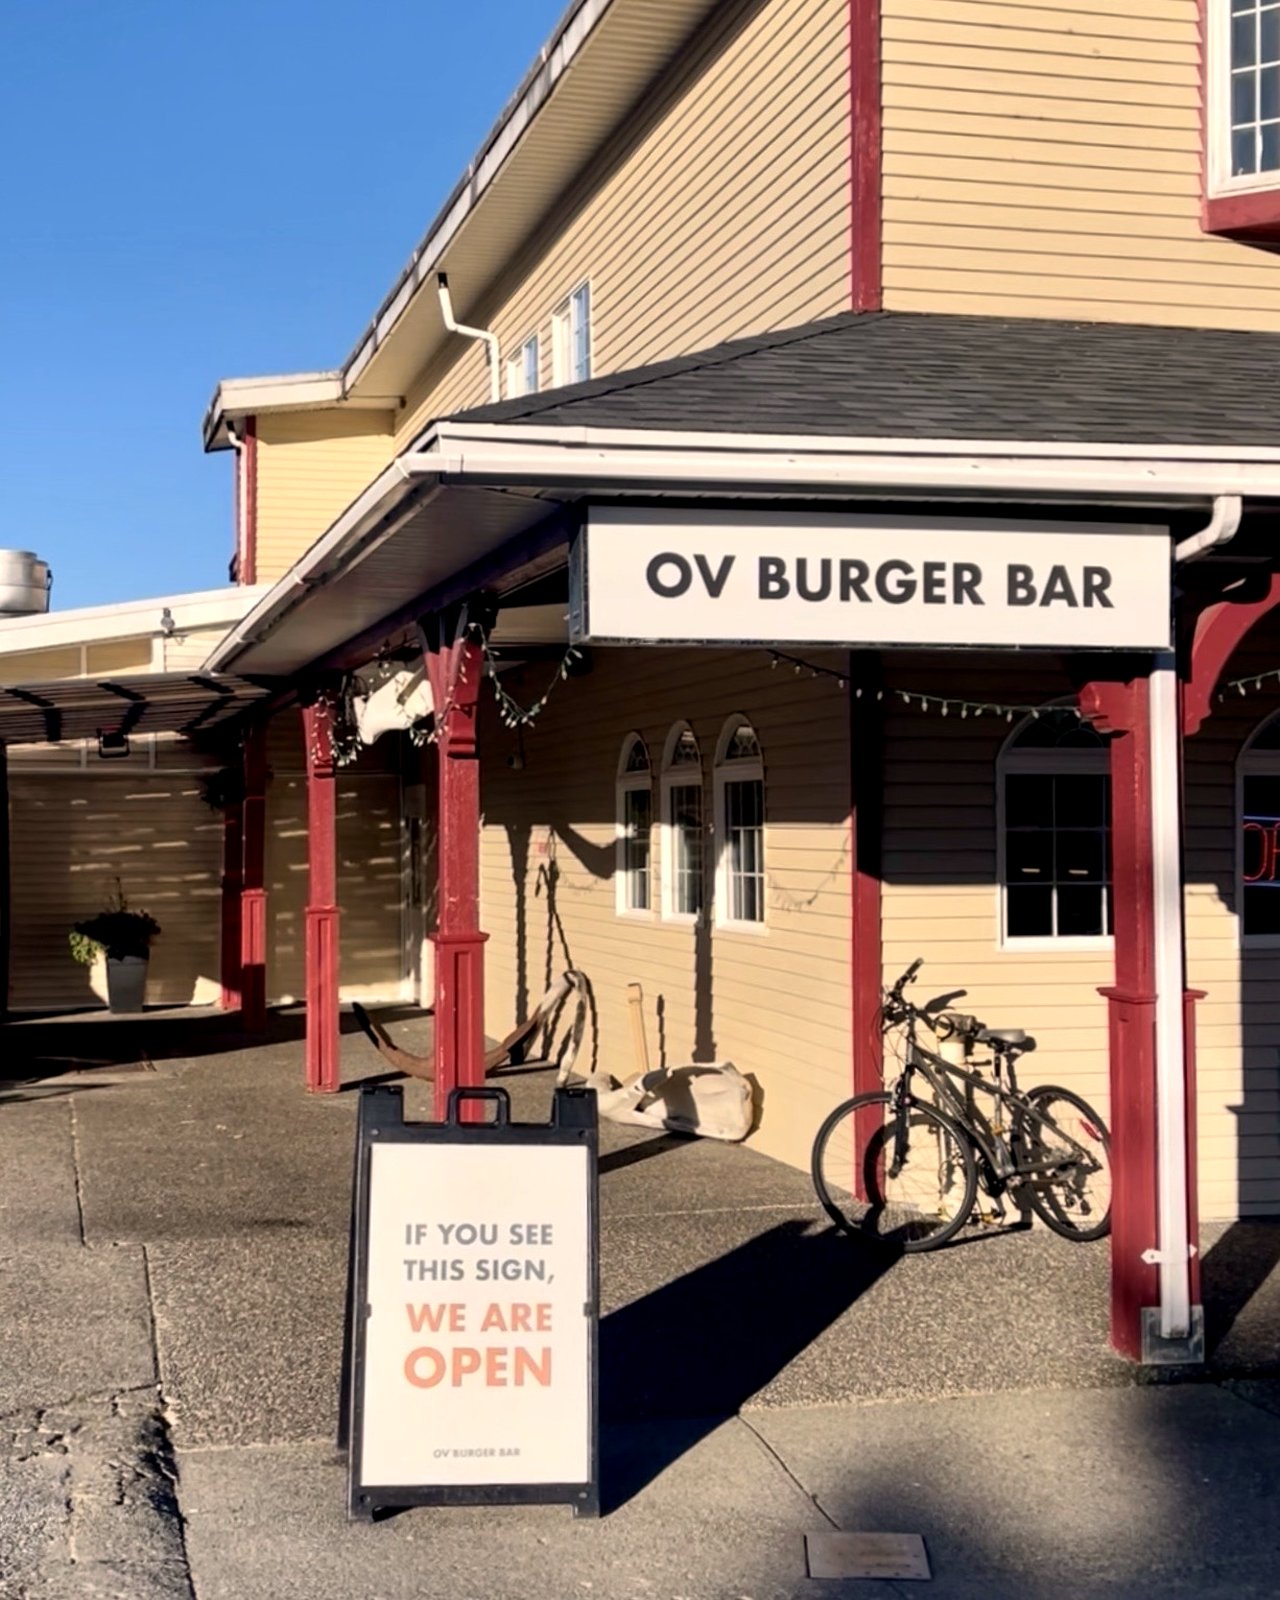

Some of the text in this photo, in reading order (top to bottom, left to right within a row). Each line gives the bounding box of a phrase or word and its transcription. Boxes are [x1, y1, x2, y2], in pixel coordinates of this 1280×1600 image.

[645, 551, 1115, 609] OV BURGER BAR
[405, 1223, 554, 1246] IF YOU SEE
[403, 1258, 555, 1285] THIS SIGN,
[405, 1302, 553, 1334] WE ARE
[402, 1345, 552, 1390] OPEN
[432, 1447, 521, 1459] OV BURGER BAR
